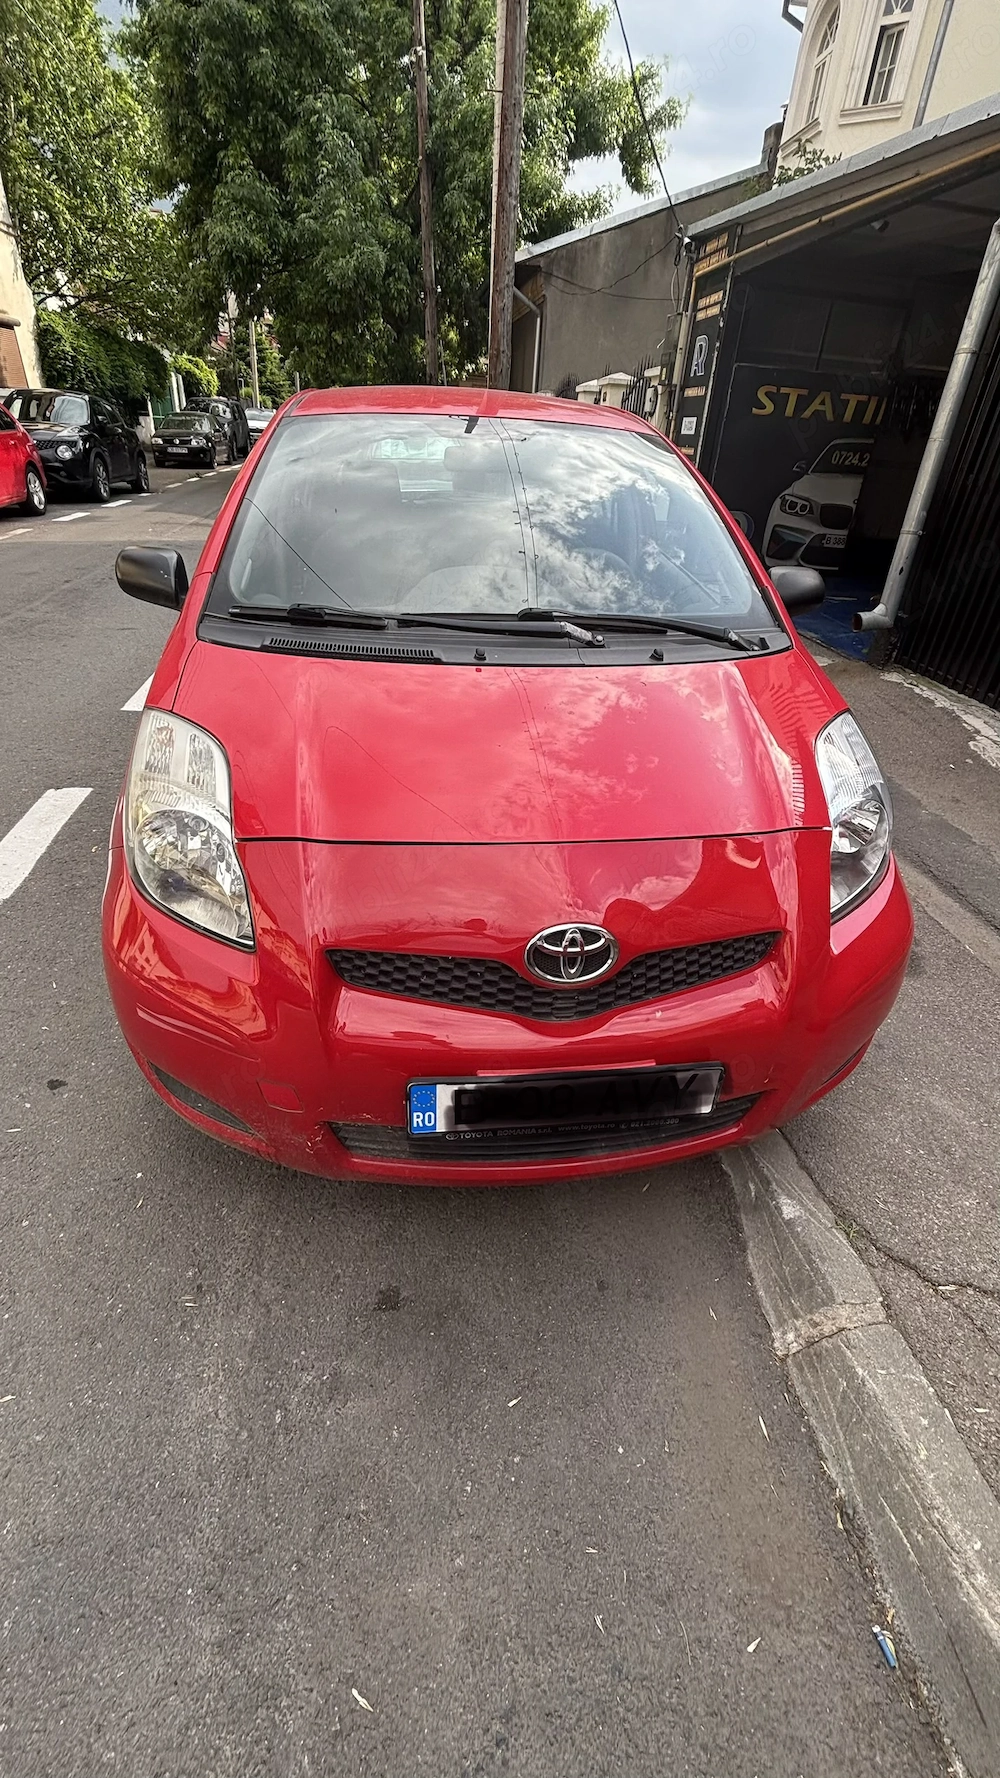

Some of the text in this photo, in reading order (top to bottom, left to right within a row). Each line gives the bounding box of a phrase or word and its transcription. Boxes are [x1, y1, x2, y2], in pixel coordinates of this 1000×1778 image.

[831, 450, 870, 467] 0724.2
[413, 1111, 435, 1128] RO
[460, 1130, 494, 1139] TOYOTA
[497, 1127, 537, 1137] ROMANIA
[557, 1122, 616, 1132] www.toyota.ro
